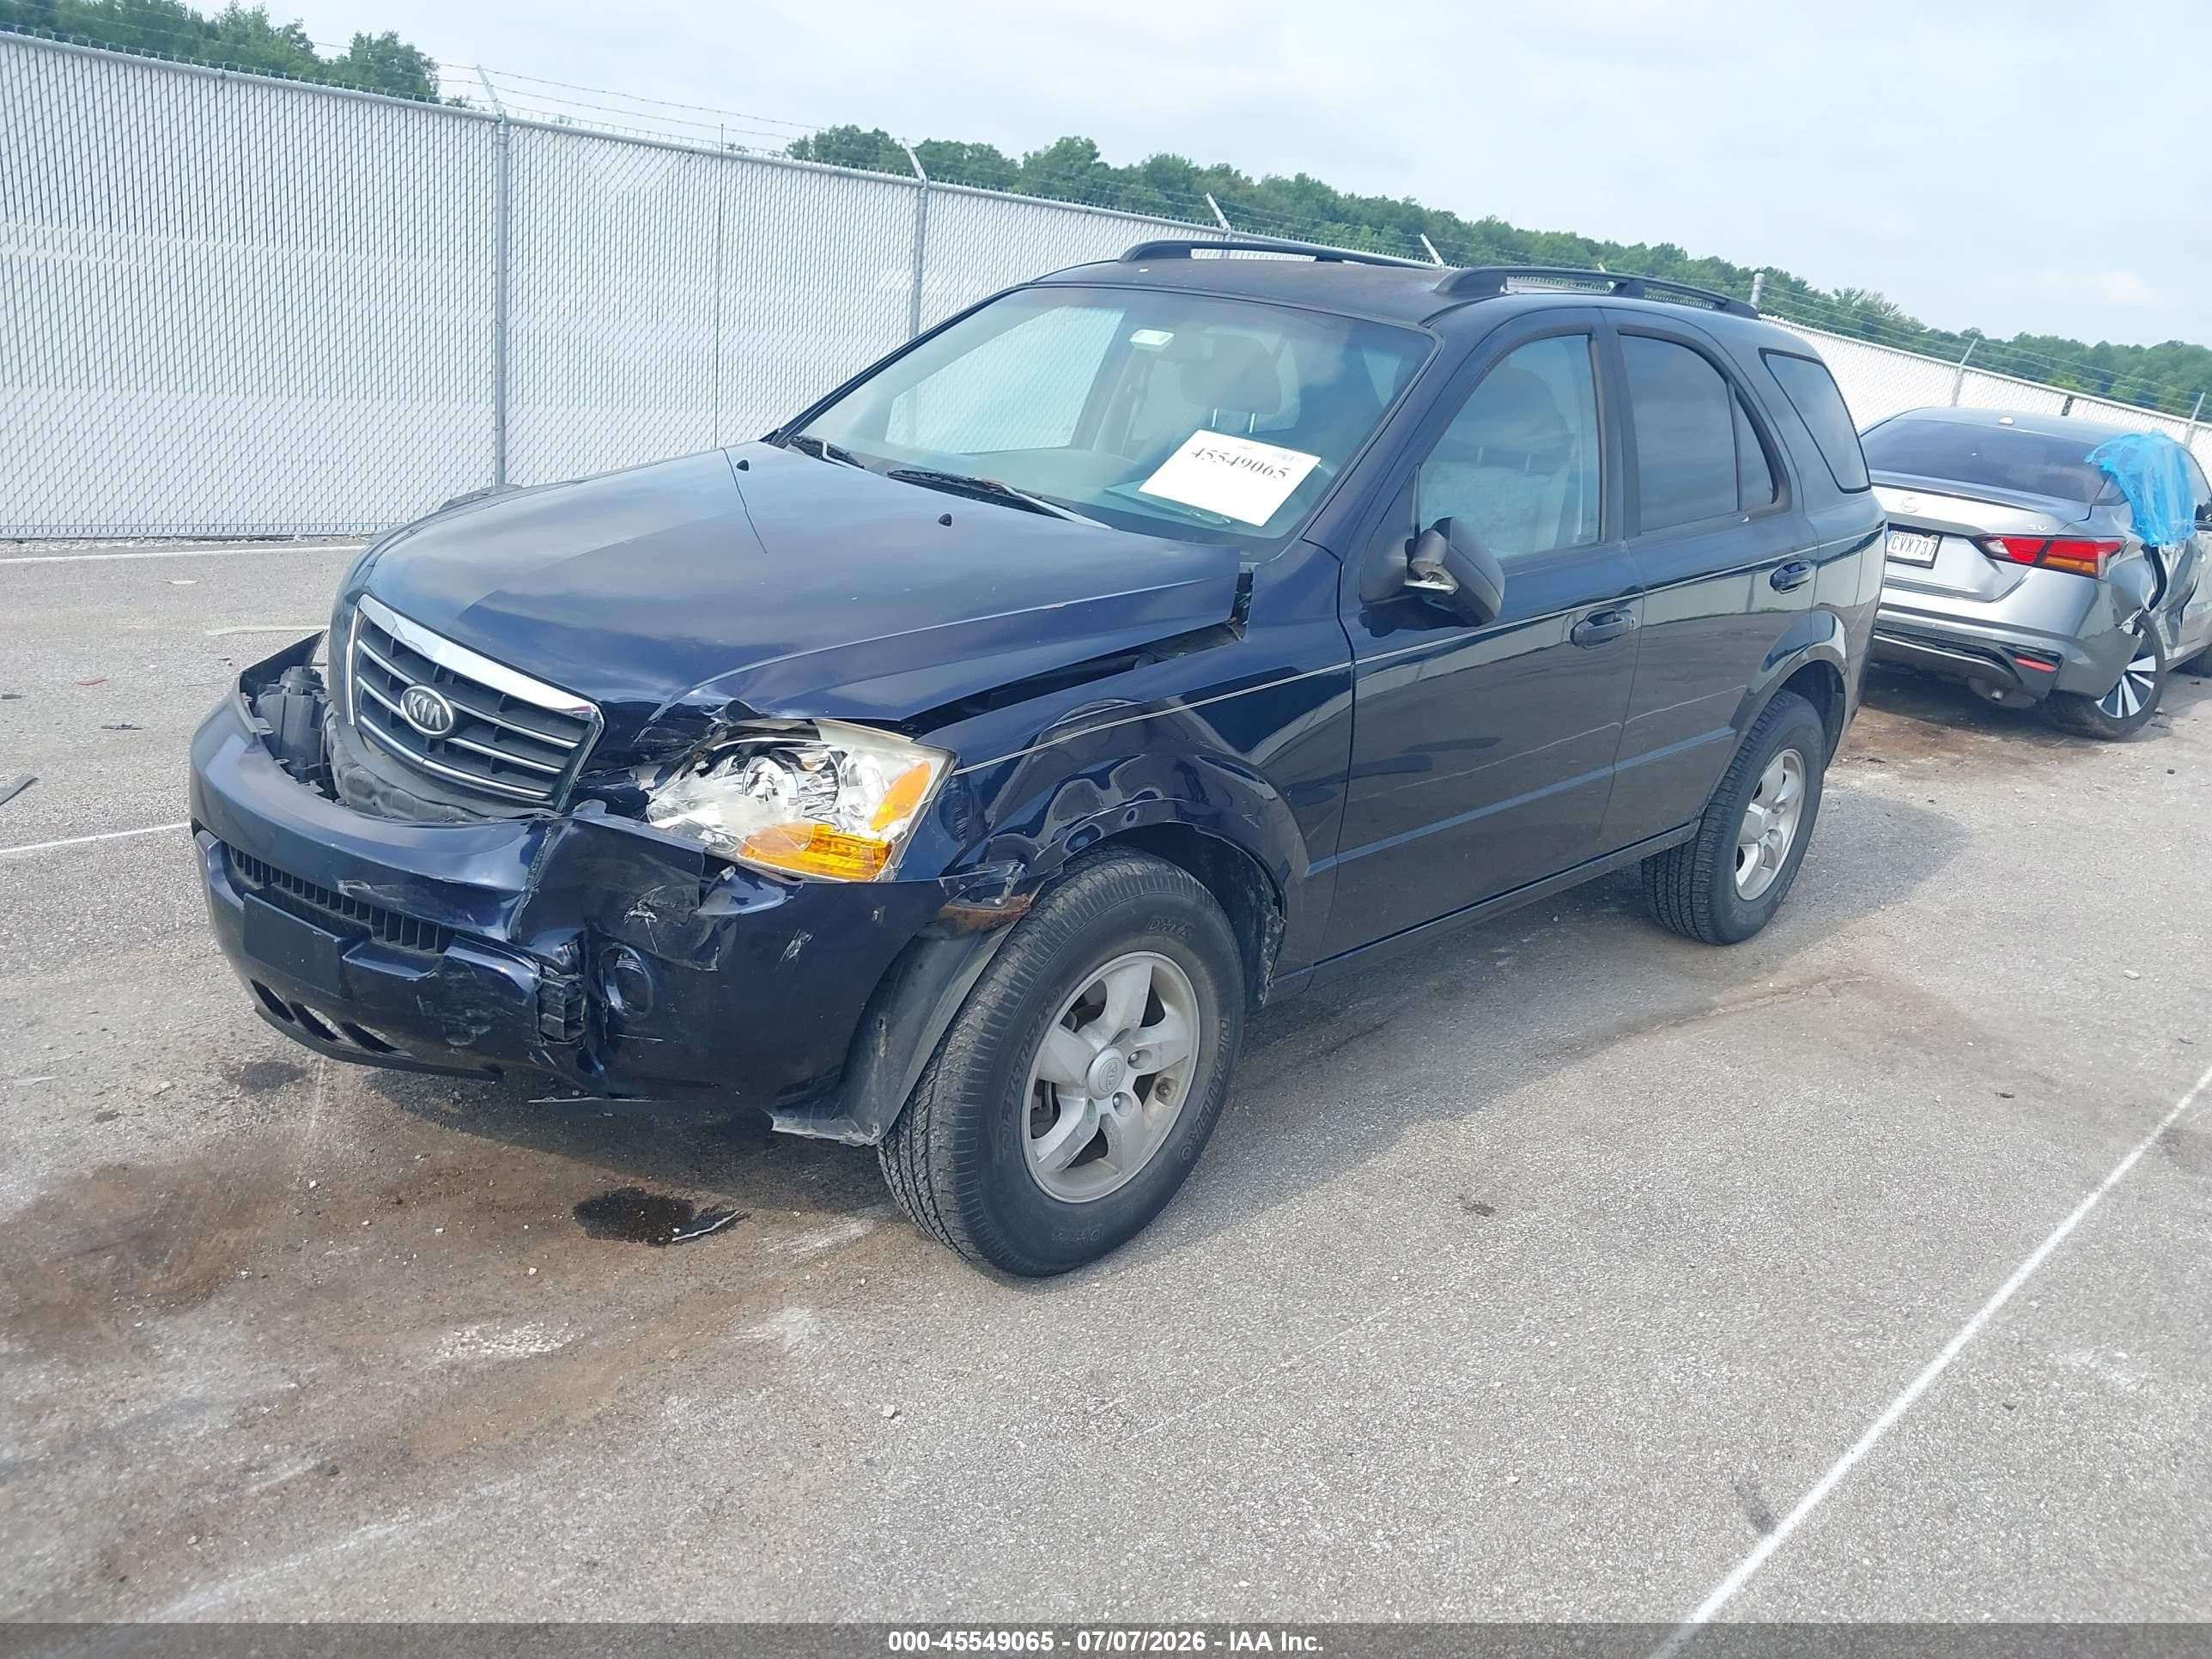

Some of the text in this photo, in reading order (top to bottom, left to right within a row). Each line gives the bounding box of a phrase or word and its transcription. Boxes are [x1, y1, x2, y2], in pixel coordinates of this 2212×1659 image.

[1191, 448, 1290, 478] 45549065
[1892, 536, 1937, 556] CVX737
[408, 693, 442, 729] KIA
